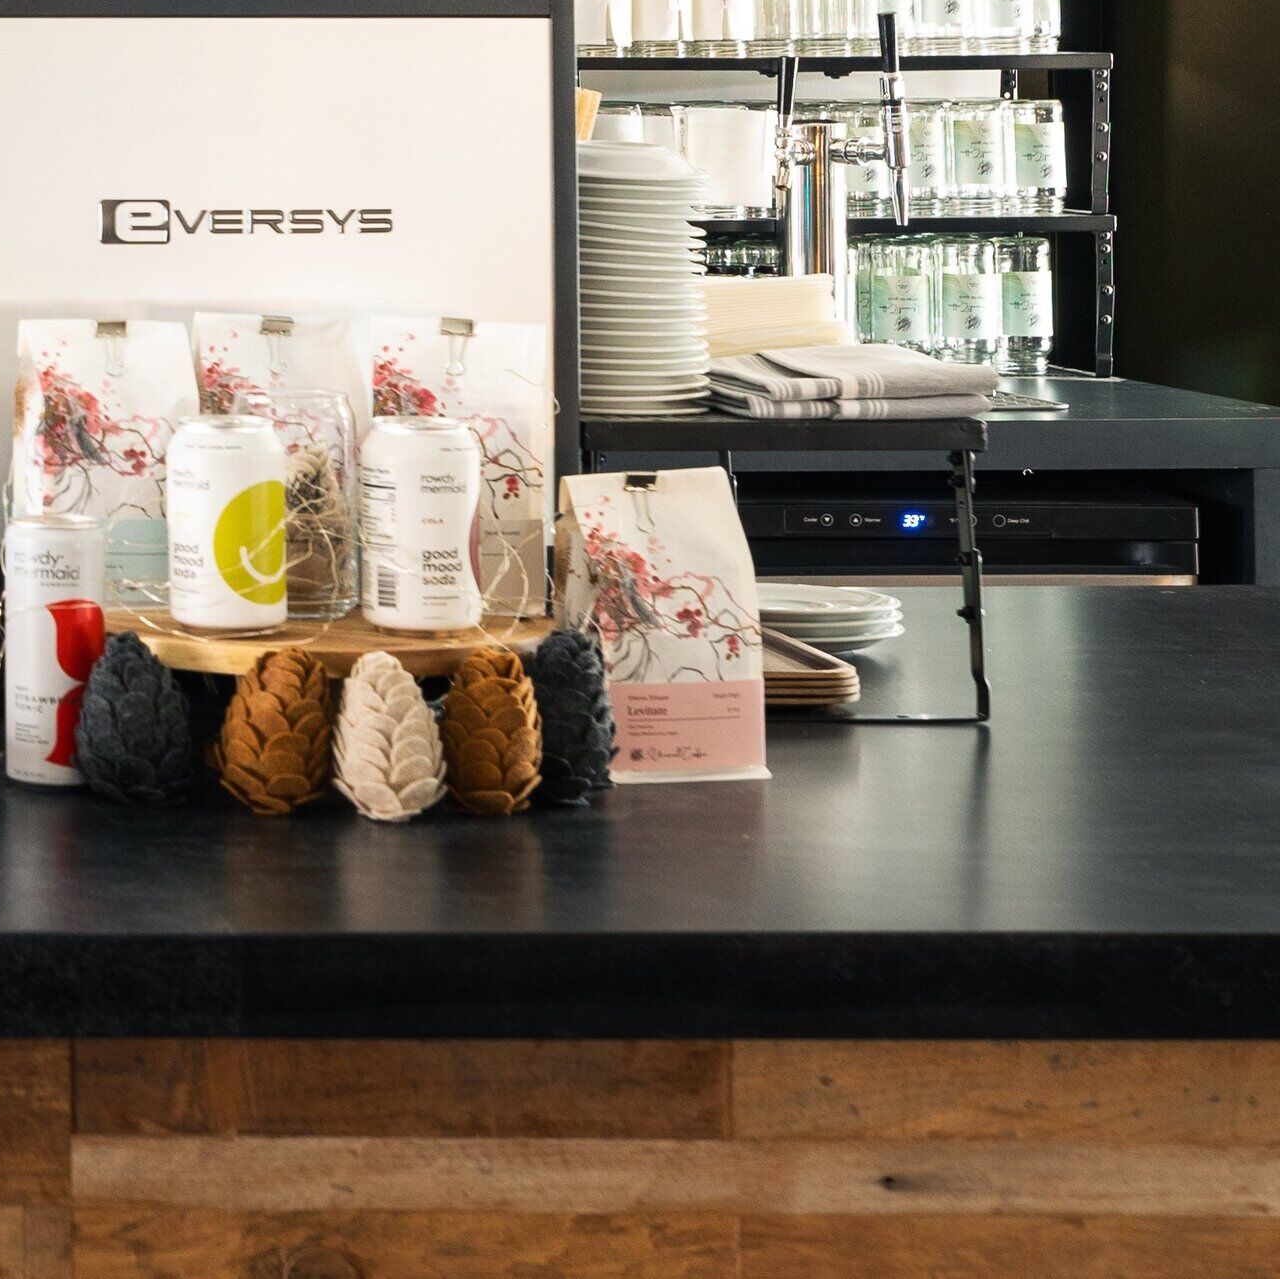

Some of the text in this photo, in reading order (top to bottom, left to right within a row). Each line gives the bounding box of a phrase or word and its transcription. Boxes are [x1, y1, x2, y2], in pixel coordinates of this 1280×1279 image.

[420, 474, 456, 486] rowdy
[420, 484, 468, 494] mermaid
[173, 543, 199, 554] good
[422, 549, 459, 562] good
[173, 555, 204, 568] mood
[422, 562, 463, 572] mood
[422, 575, 457, 586] soda
